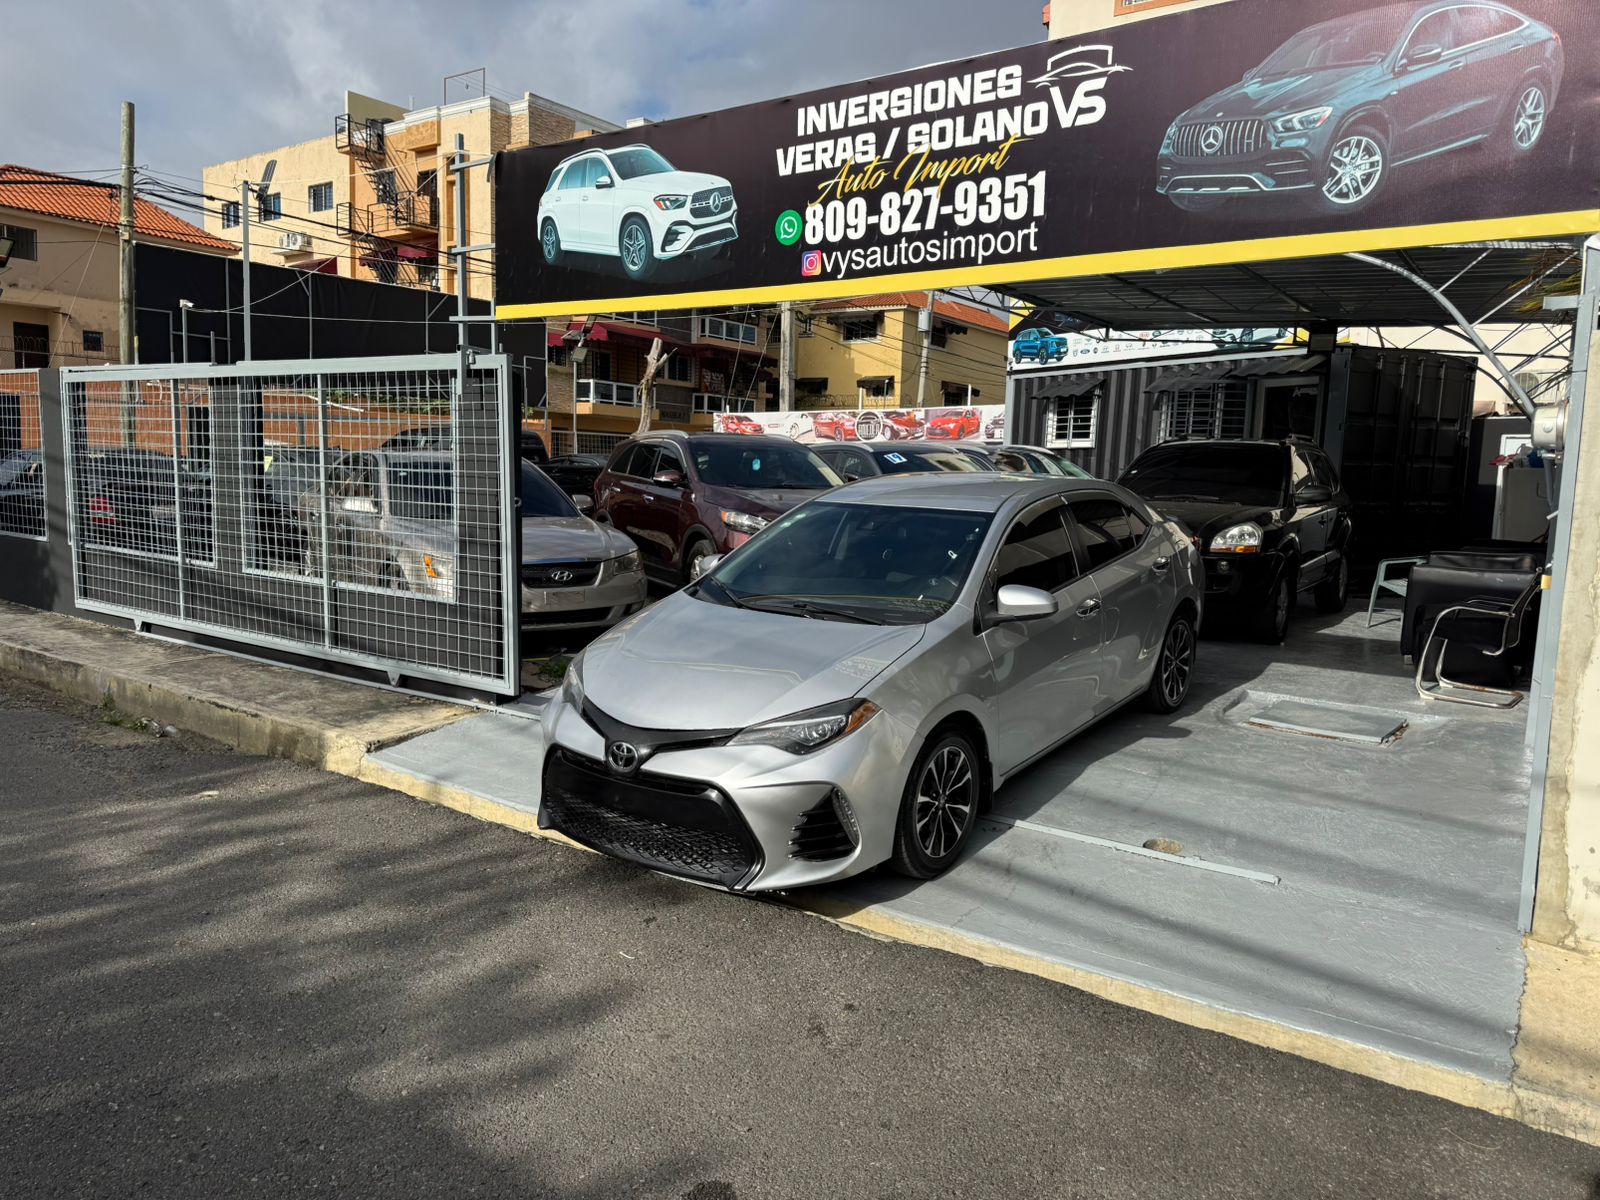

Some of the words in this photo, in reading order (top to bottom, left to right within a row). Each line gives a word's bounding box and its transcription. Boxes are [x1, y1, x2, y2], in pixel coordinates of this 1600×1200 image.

[797, 64, 1022, 137] INVERSIONES
[1050, 77, 1107, 129] VS
[775, 132, 876, 177] VERAS
[882, 127, 901, 160] /
[907, 101, 1049, 154] SOLANO
[808, 154, 892, 208] Auto
[893, 133, 1034, 200] Import
[804, 170, 1047, 245] 809-827-9351
[822, 221, 1038, 280] vysautosimport
